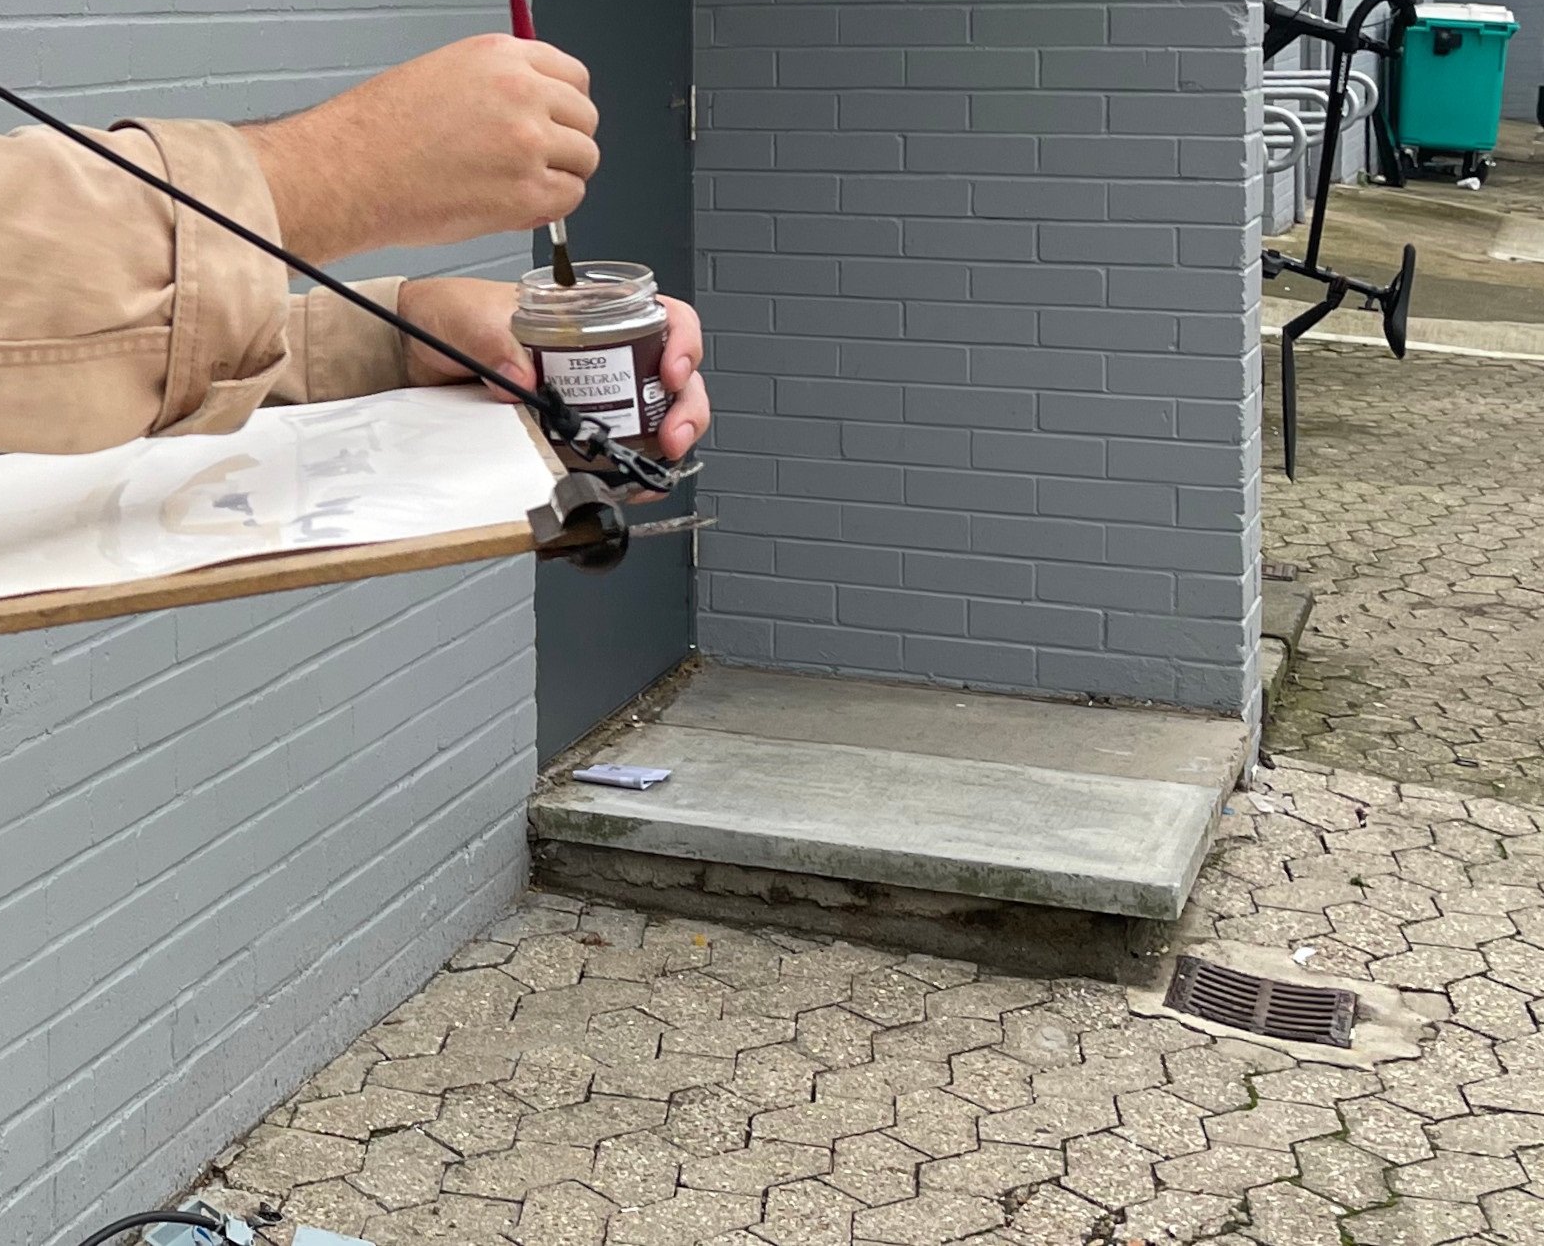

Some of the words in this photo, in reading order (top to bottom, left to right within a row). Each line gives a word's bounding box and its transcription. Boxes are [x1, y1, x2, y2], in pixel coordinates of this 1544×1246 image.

[568, 356, 607, 367] TESCO
[547, 371, 631, 385] WHOLEGRAIN
[561, 384, 621, 398] MUSTARD
